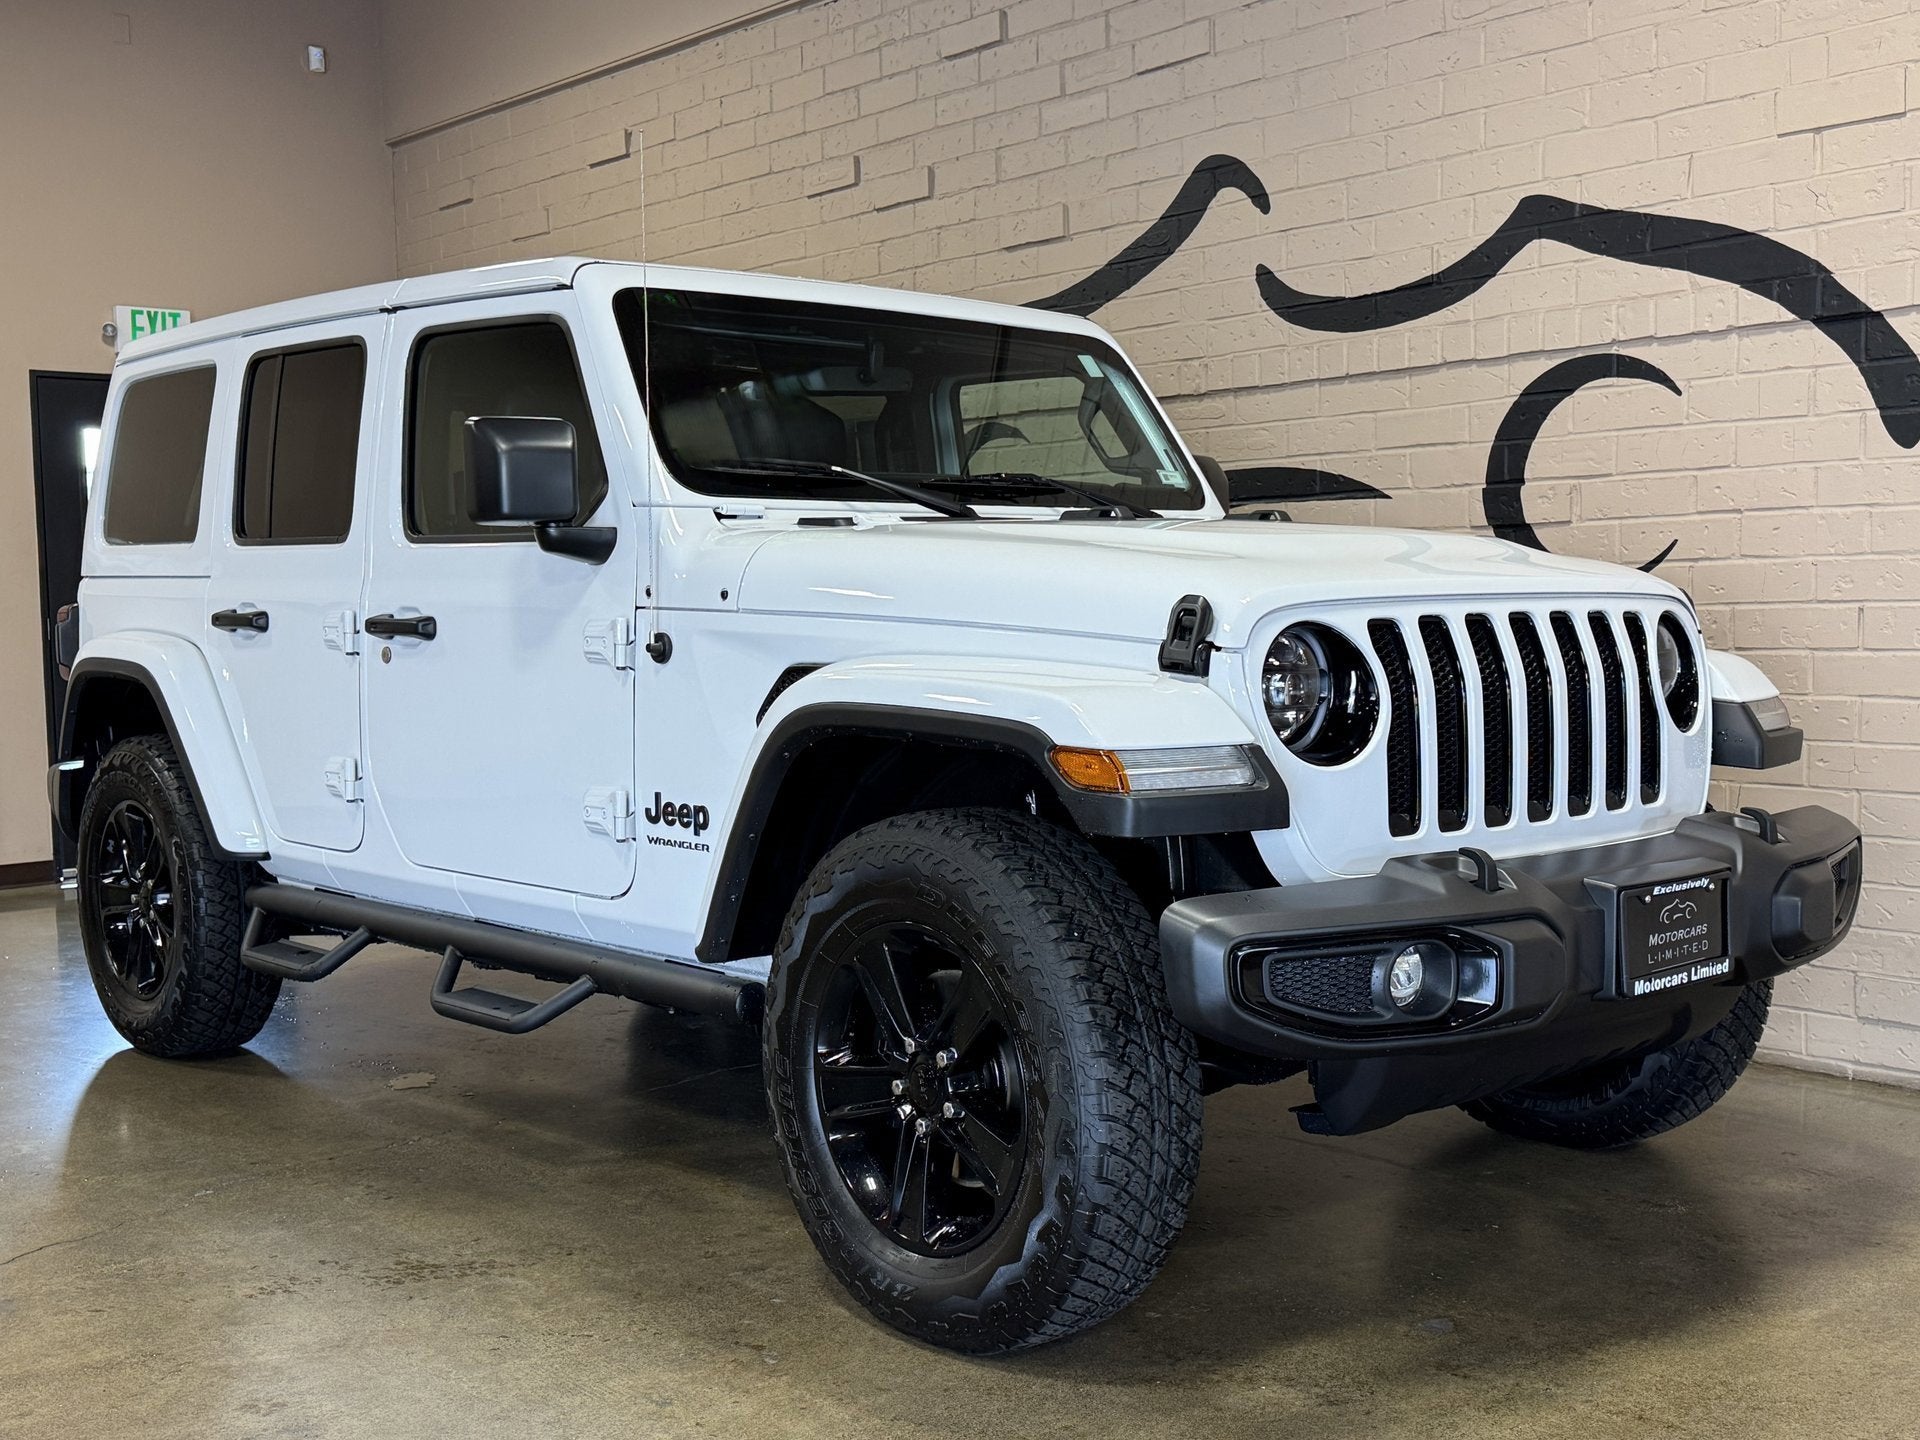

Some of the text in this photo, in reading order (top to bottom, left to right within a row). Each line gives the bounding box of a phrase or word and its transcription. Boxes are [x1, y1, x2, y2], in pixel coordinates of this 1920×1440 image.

[645, 791, 710, 837] Jeep
[647, 835, 710, 852] WRANGLER
[1653, 877, 1710, 896] Exclusively
[1648, 924, 1708, 946] MOTORCARS
[1634, 959, 1729, 996] Motorcars Limited
